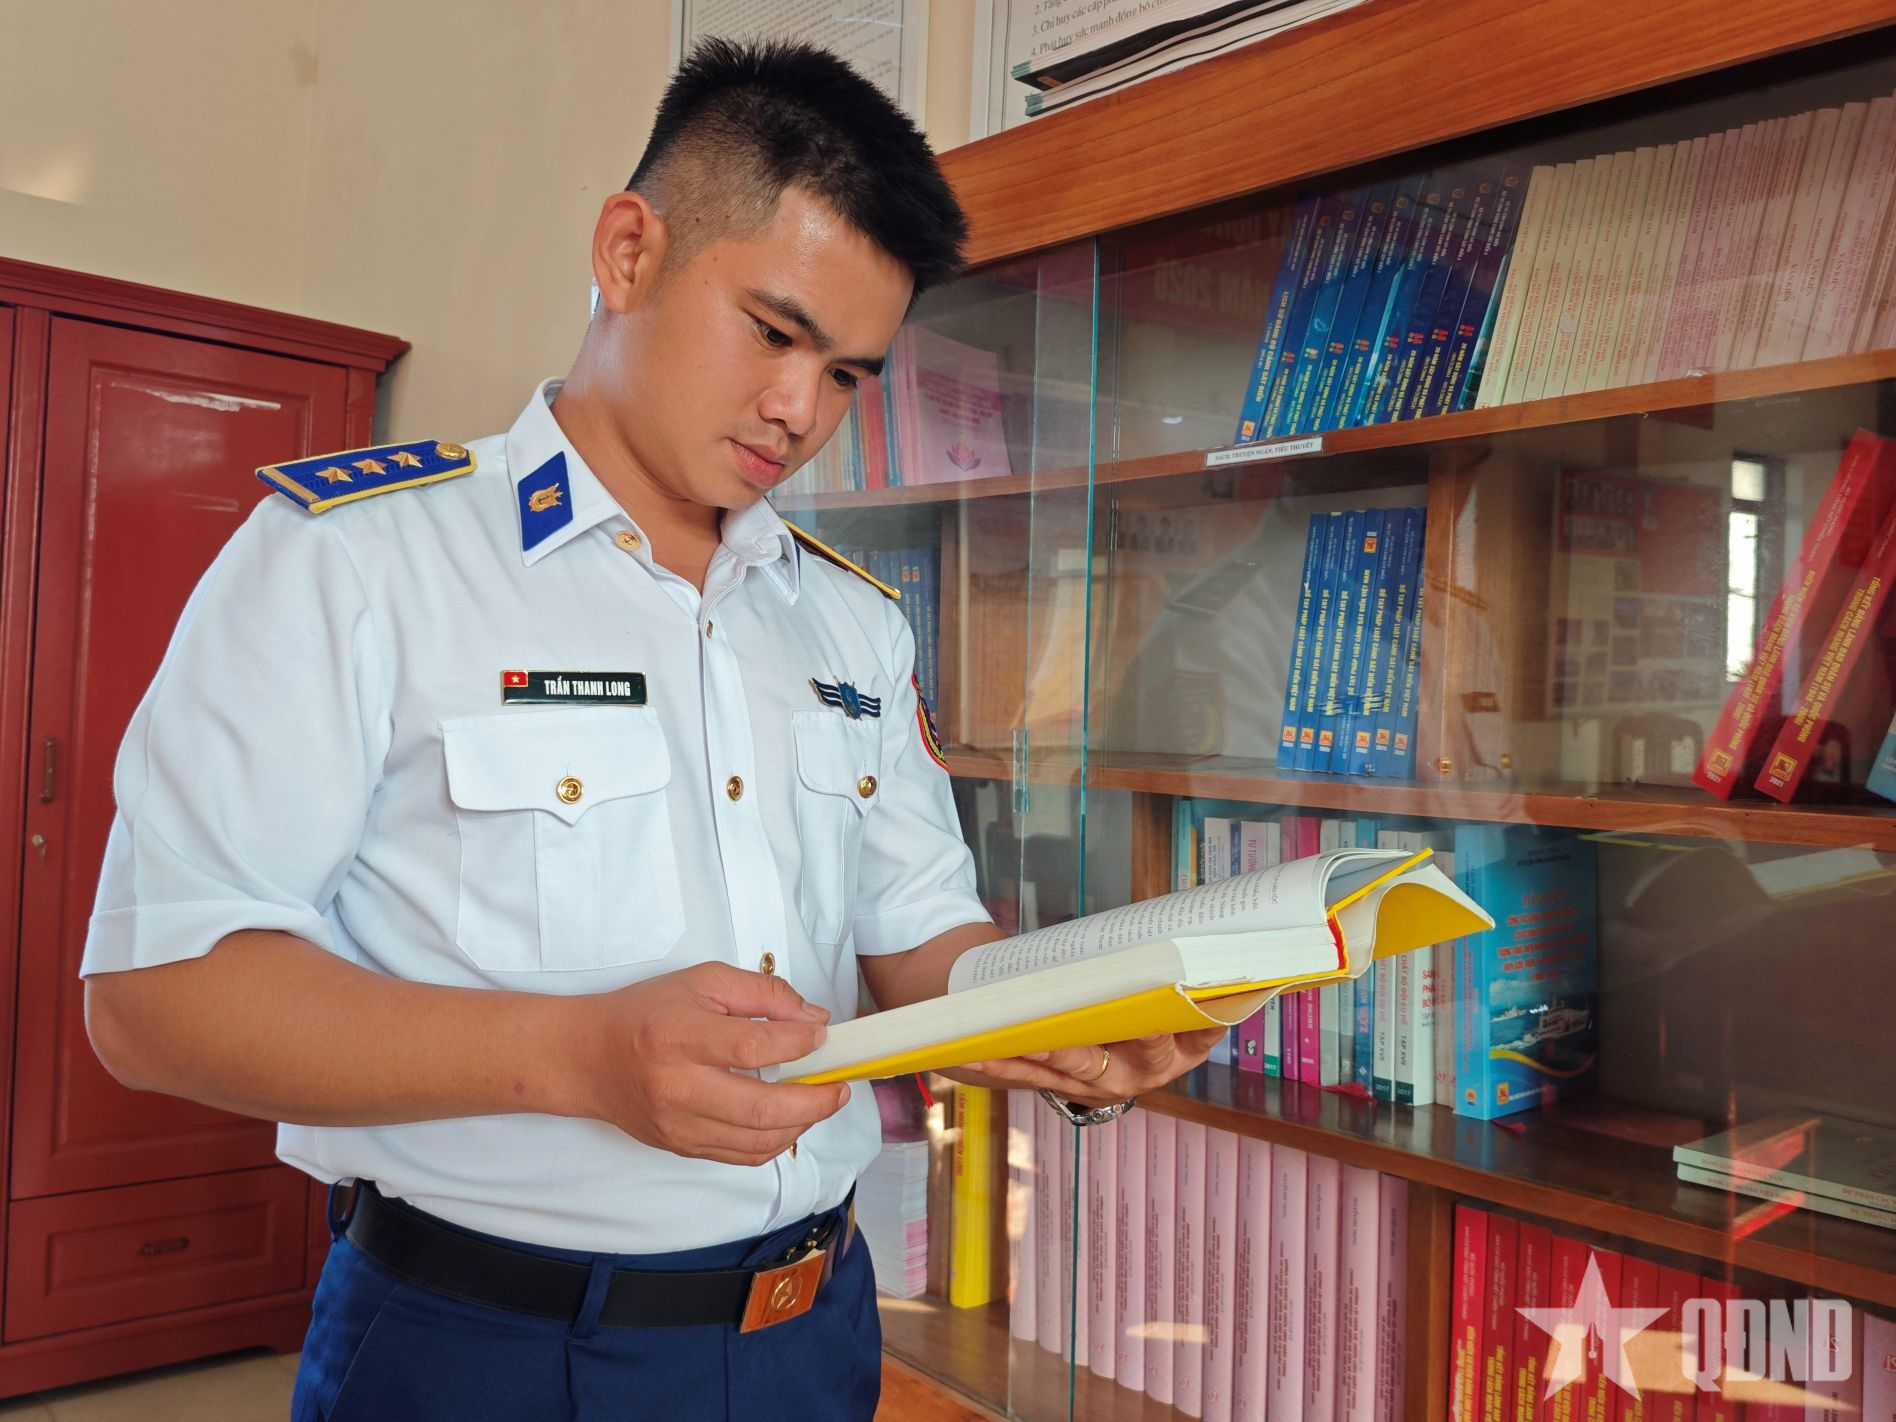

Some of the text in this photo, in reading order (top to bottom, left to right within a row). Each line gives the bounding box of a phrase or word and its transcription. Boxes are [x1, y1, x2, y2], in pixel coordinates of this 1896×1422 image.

[572, 680, 604, 696] THANH
[605, 681, 631, 697] LONG
[1375, 1083, 1390, 1092] 2017
[1396, 1087, 1412, 1096] 2017
